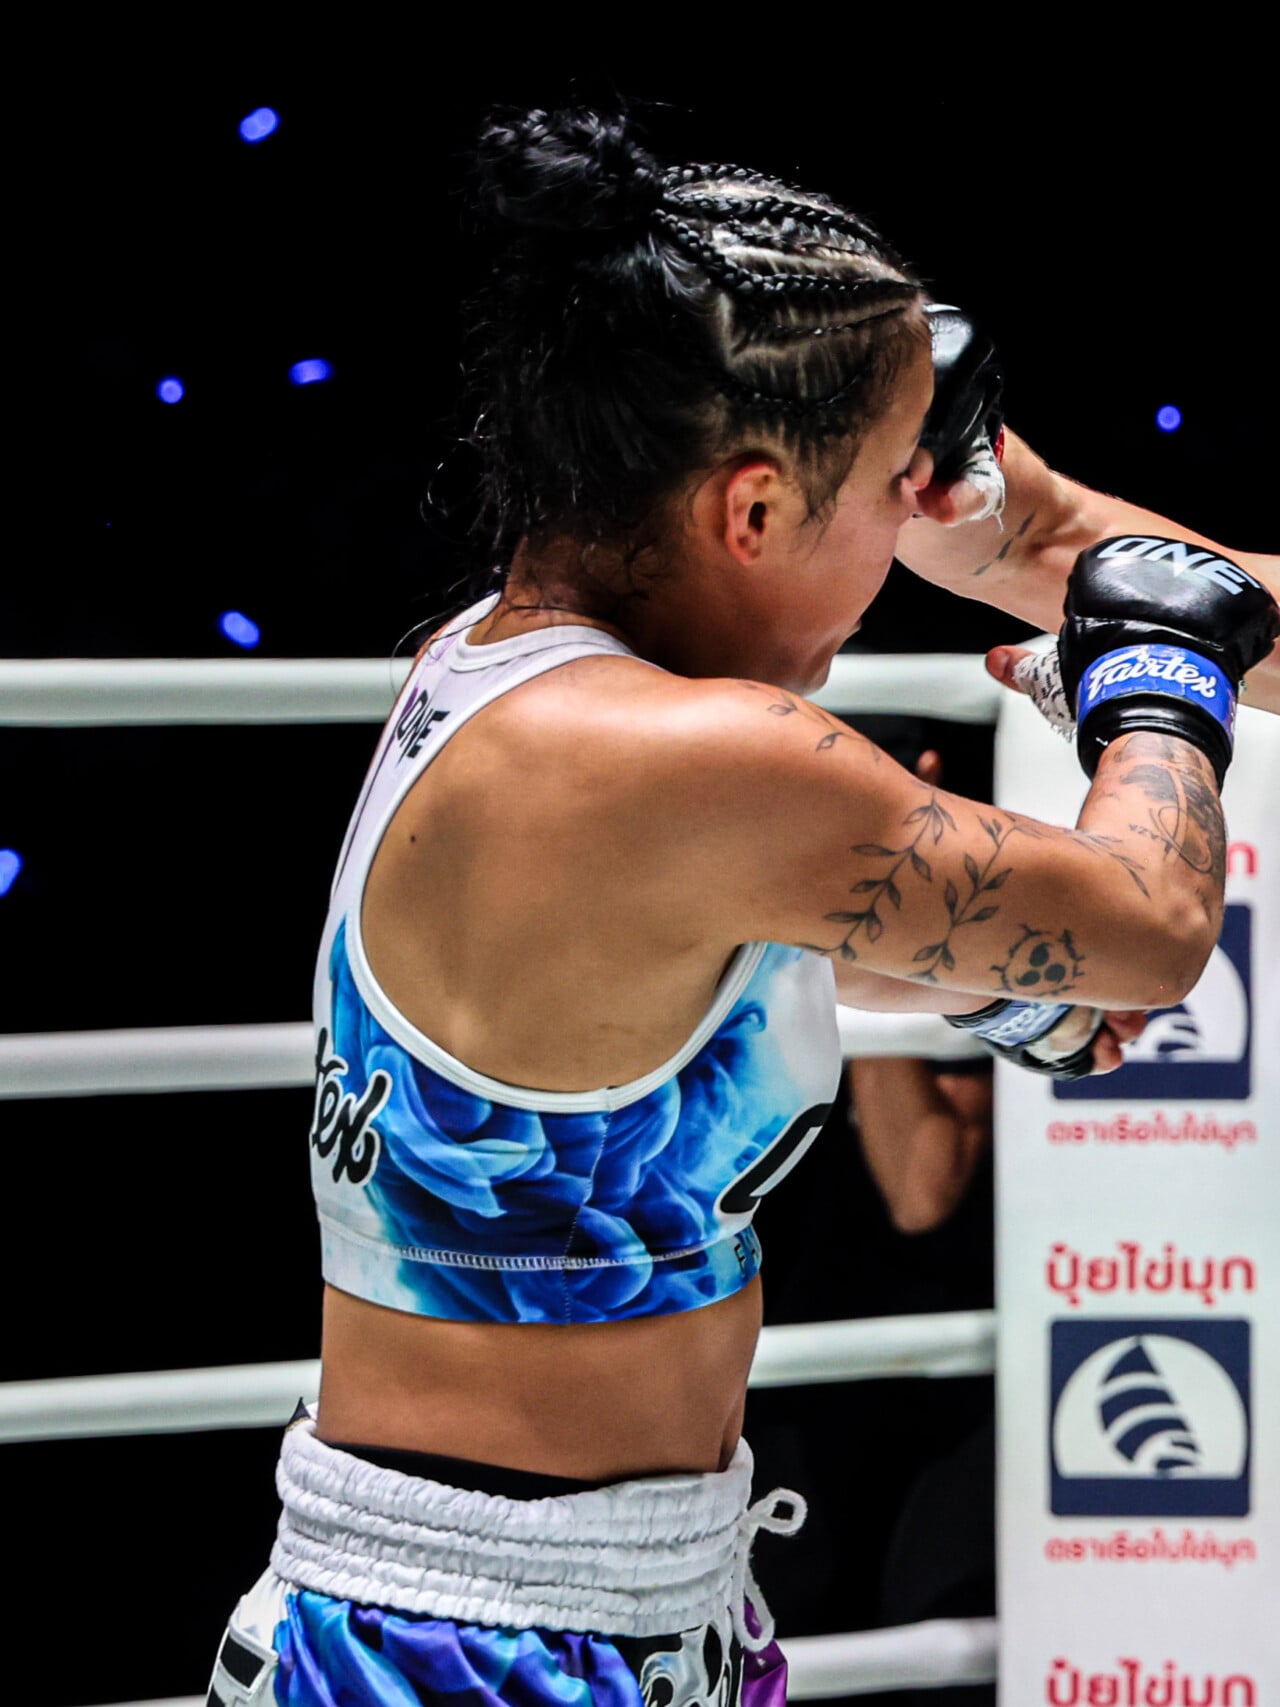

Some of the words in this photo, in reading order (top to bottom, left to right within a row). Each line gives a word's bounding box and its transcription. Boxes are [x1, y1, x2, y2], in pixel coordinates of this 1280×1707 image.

[1097, 536, 1262, 596] ONE
[1088, 644, 1217, 701] Fairtex
[1045, 1241, 1257, 1305] ปุ๋ยไข่มุก
